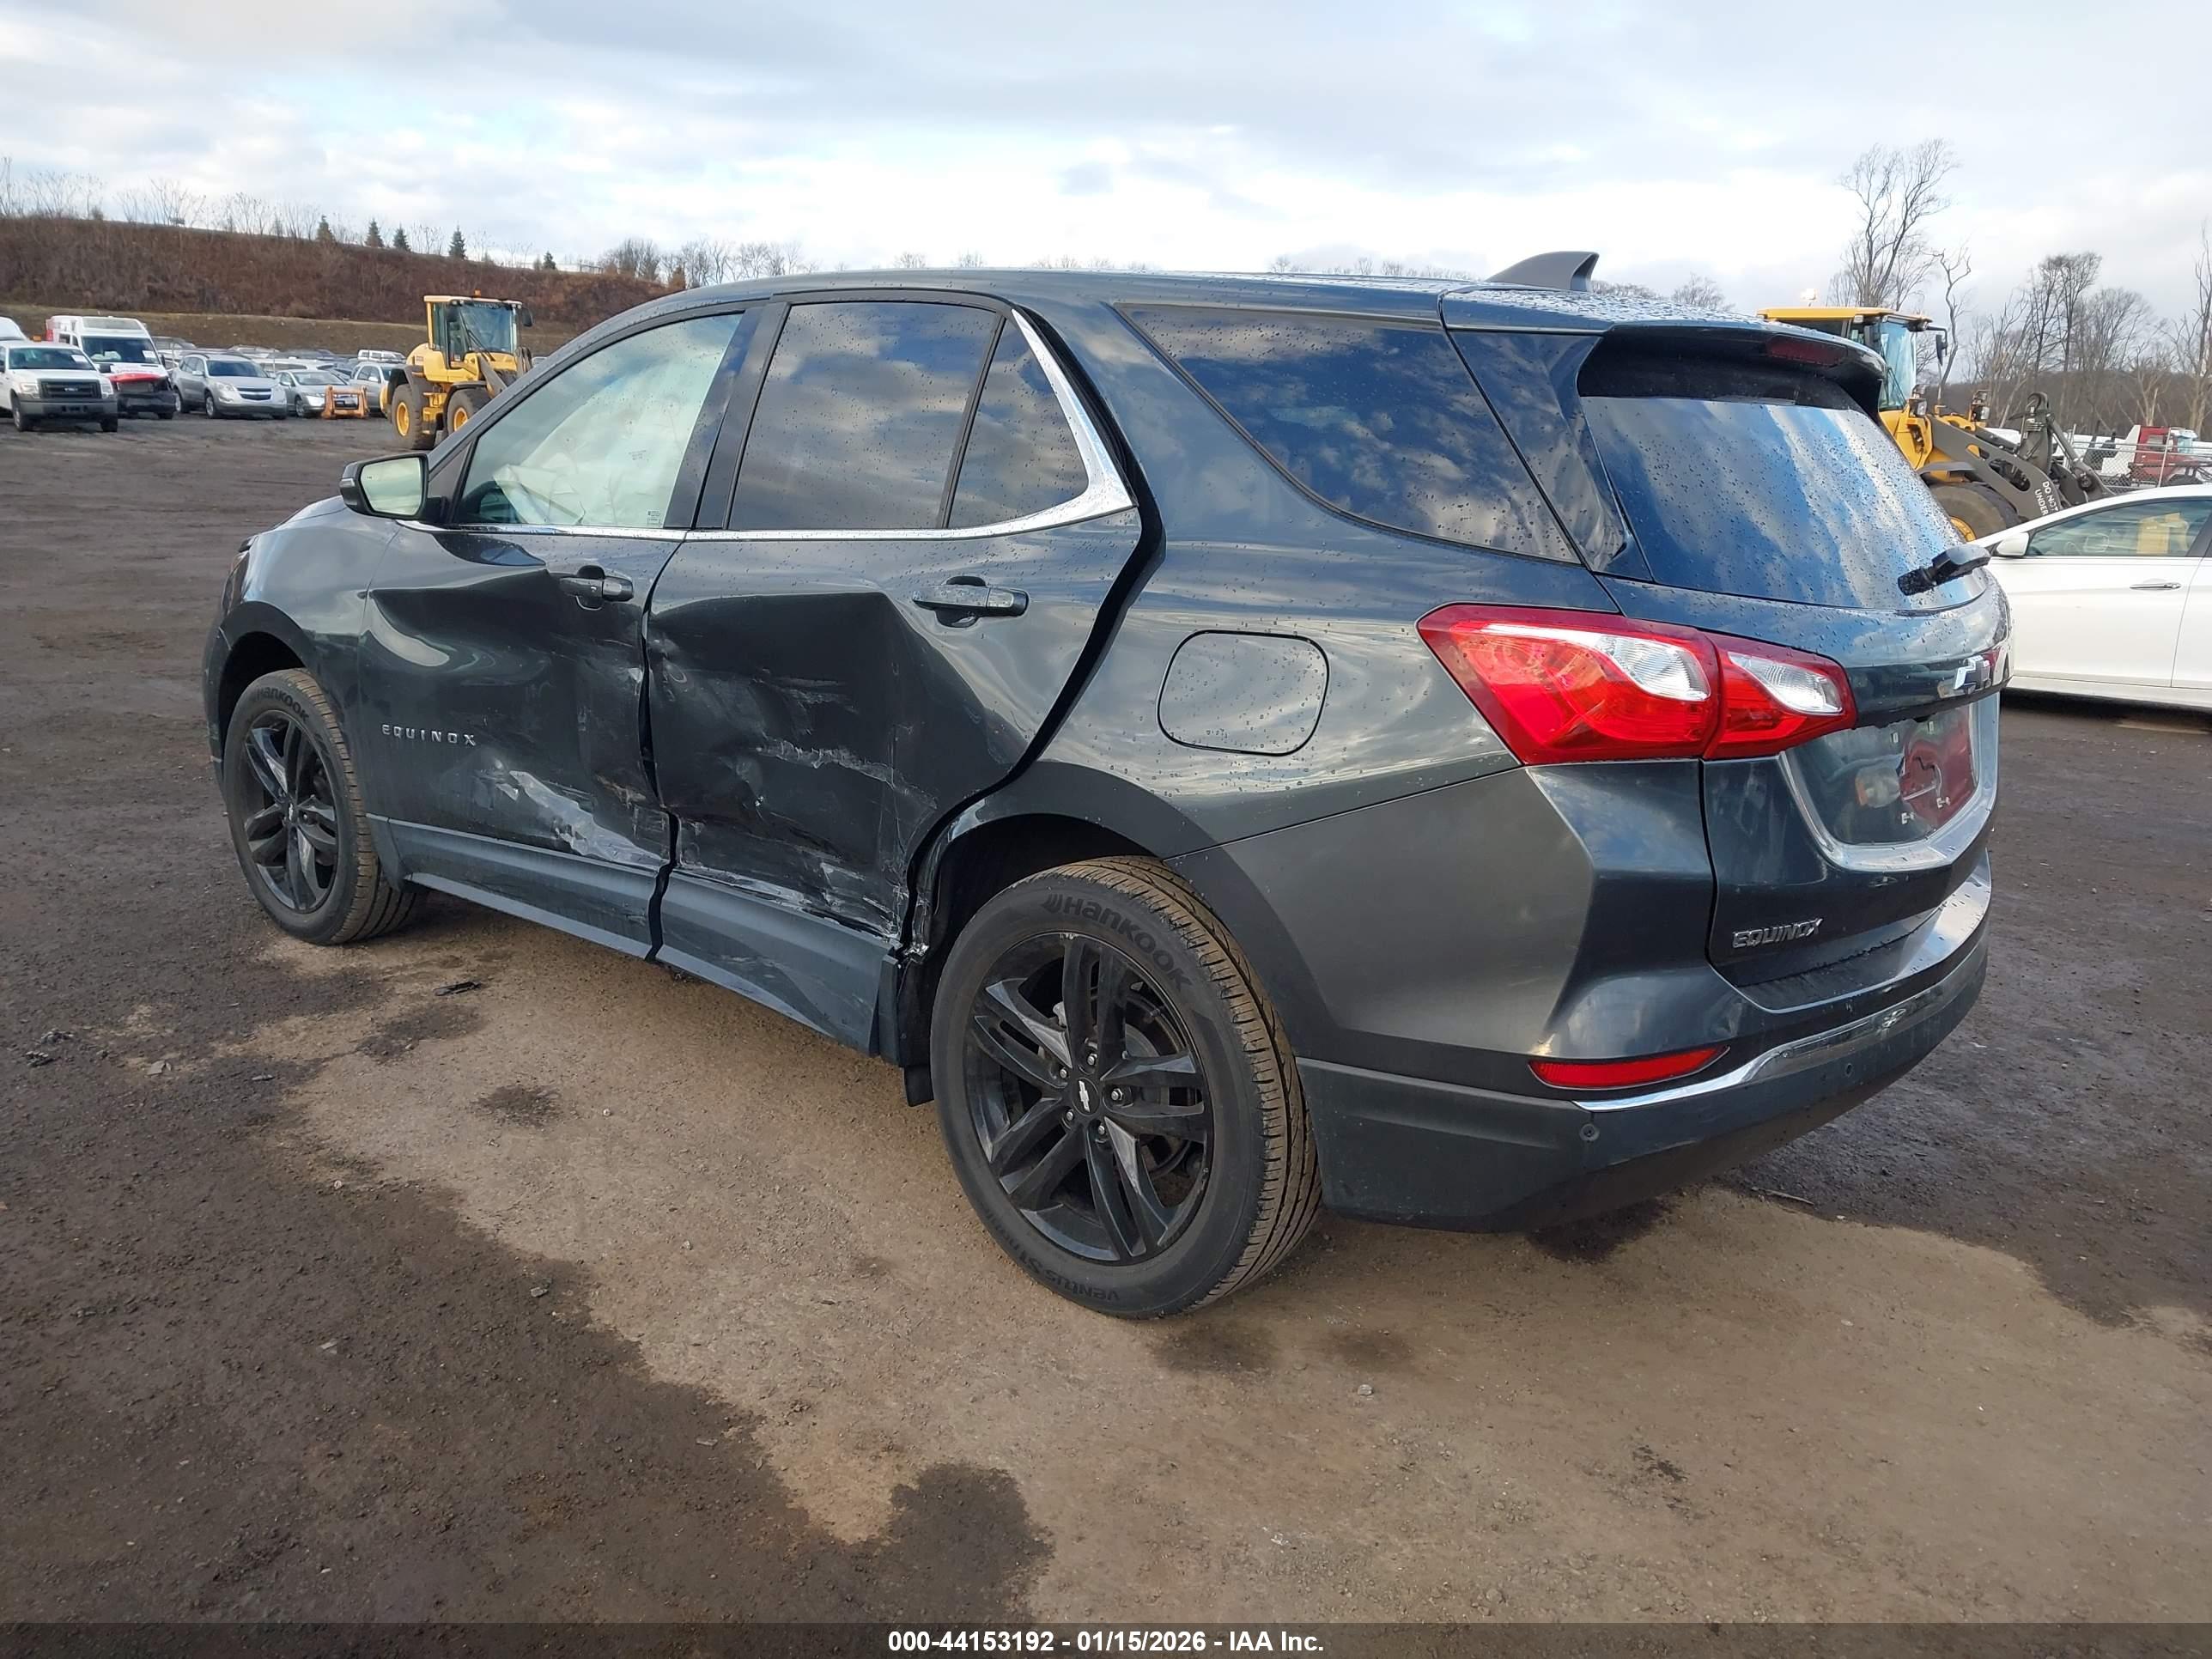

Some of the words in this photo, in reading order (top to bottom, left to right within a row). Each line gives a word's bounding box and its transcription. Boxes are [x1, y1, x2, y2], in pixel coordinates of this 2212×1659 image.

[2042, 481, 2051, 494] DO
[2035, 489, 2049, 516] UNDER
[2046, 494, 2059, 512] NOT
[381, 724, 477, 746] EQUINOX
[1733, 918, 1823, 949] EQUINOX
